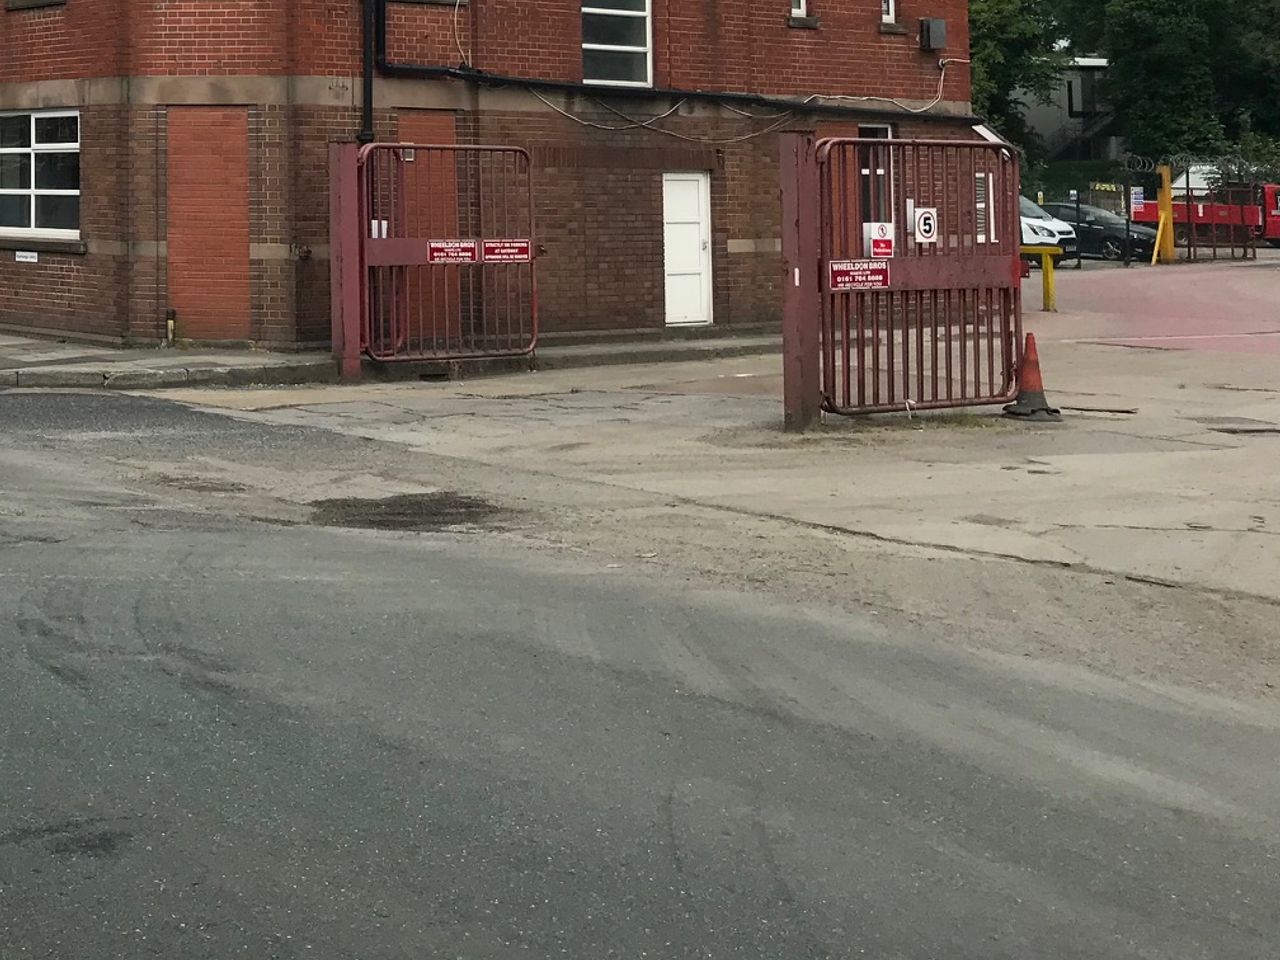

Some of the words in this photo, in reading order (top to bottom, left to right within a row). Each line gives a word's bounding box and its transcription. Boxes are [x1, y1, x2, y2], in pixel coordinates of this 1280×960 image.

[923, 216, 932, 234] 5
[831, 262, 868, 271] WHEELDON
[869, 261, 887, 270] BROS
